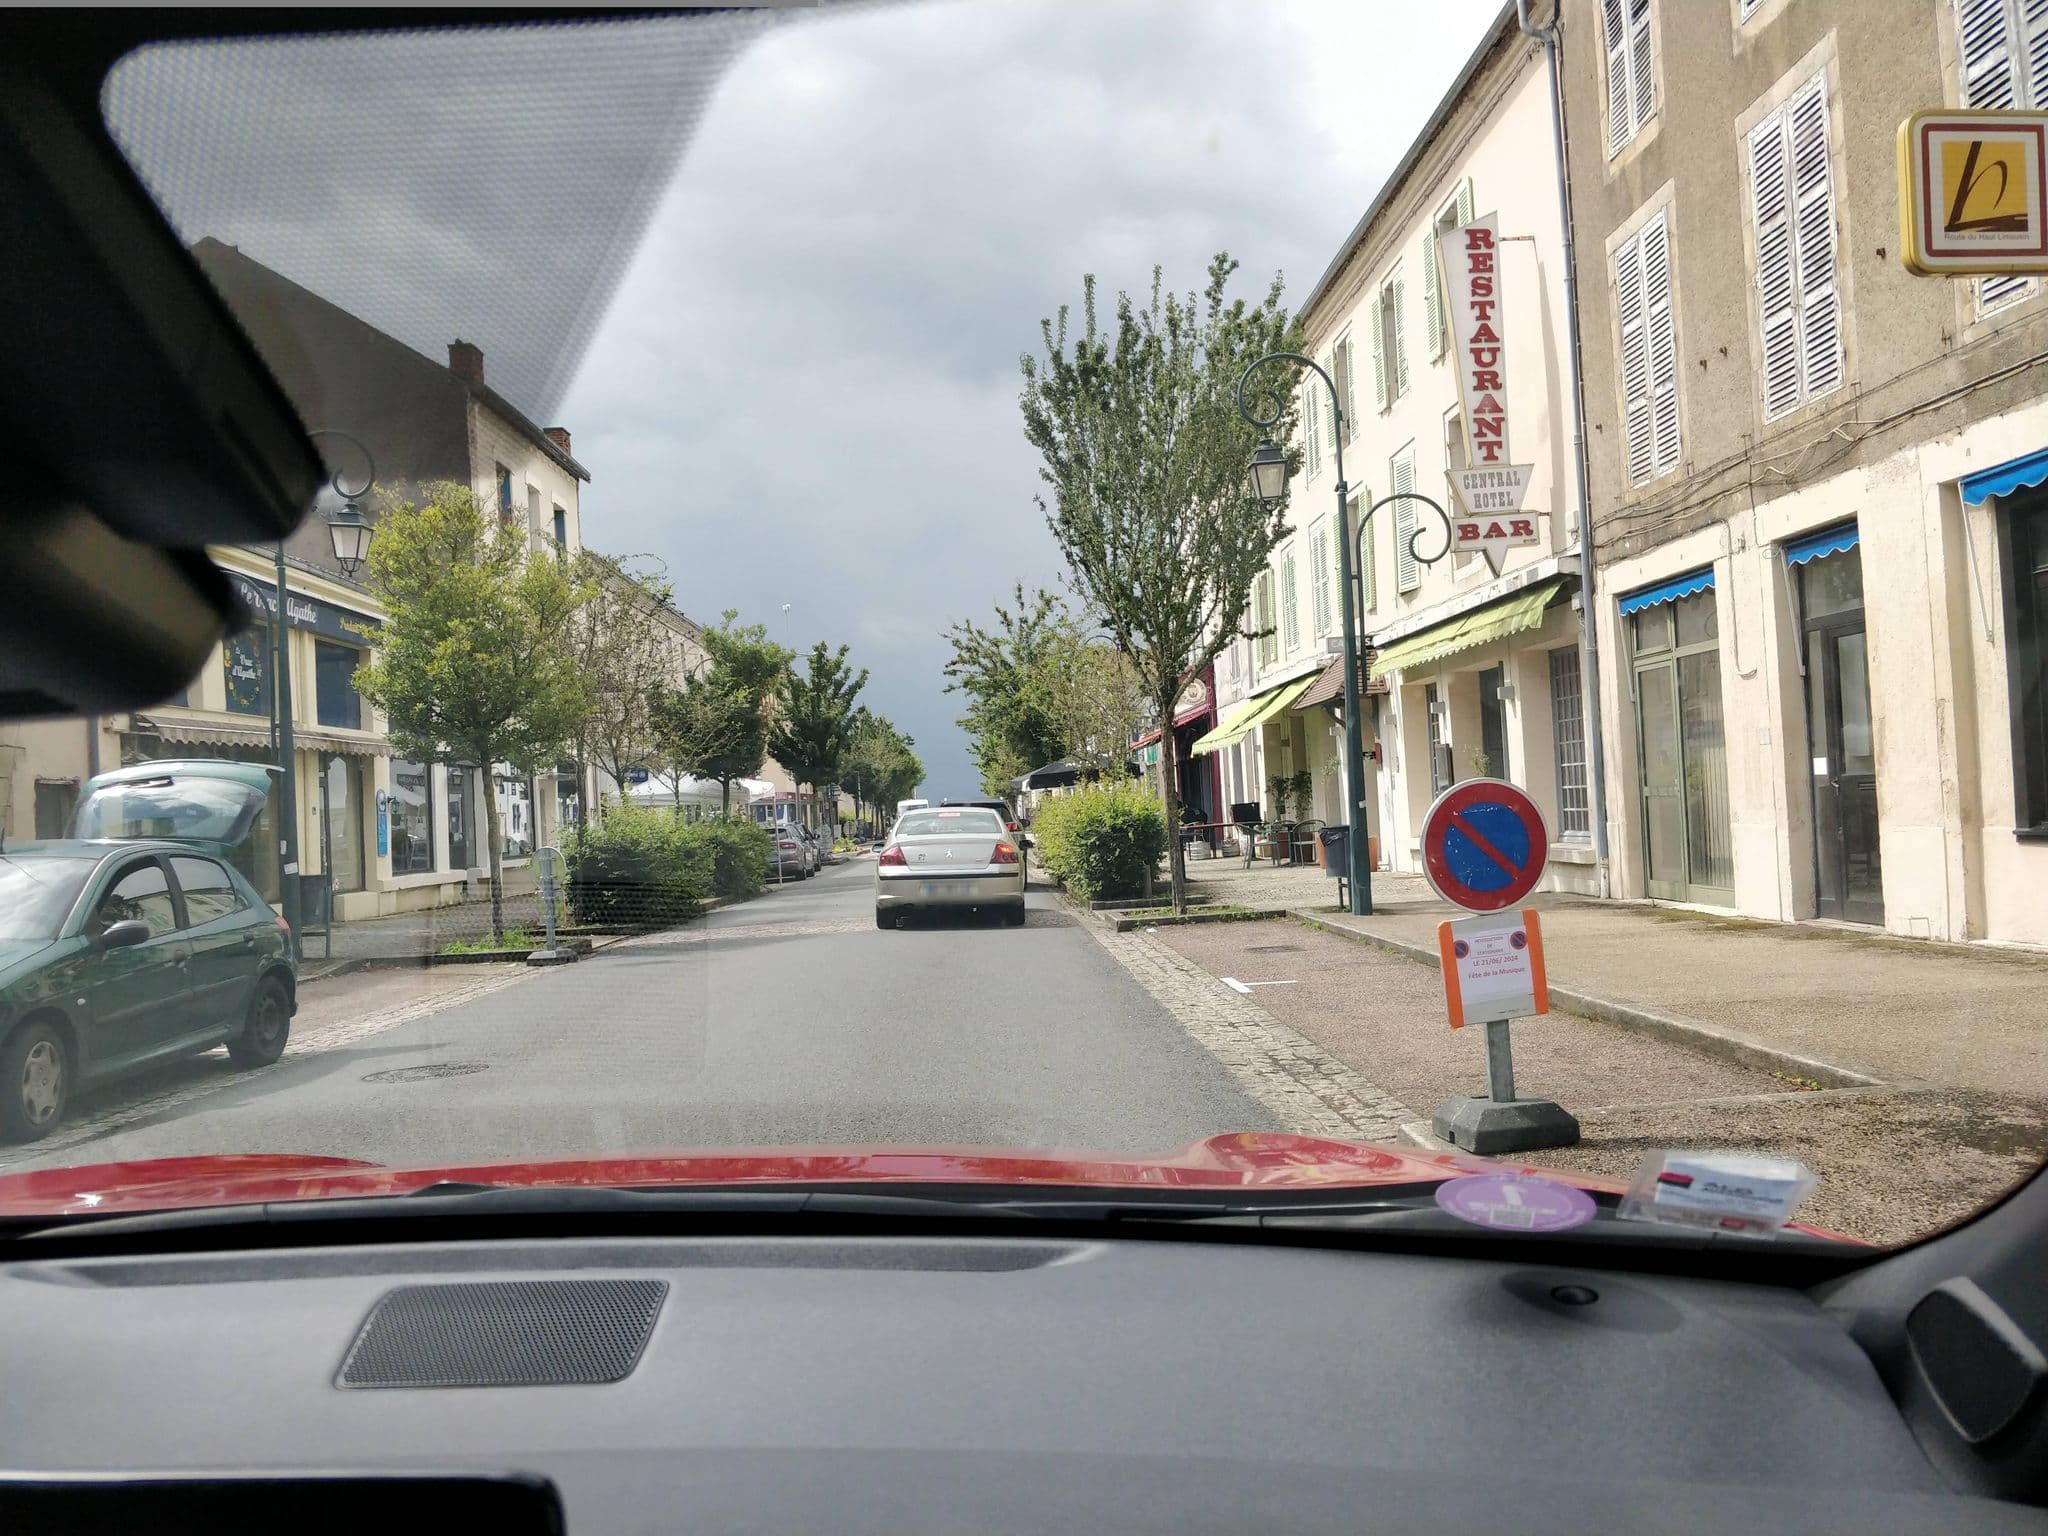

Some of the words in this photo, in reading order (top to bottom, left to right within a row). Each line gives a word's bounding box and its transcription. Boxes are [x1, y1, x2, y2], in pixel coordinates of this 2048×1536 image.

[1464, 227, 1506, 462] RESTAURANT
[1463, 470, 1520, 490] CENTRAL
[1473, 491, 1514, 509] HOTEL
[1457, 519, 1534, 542] BAR
